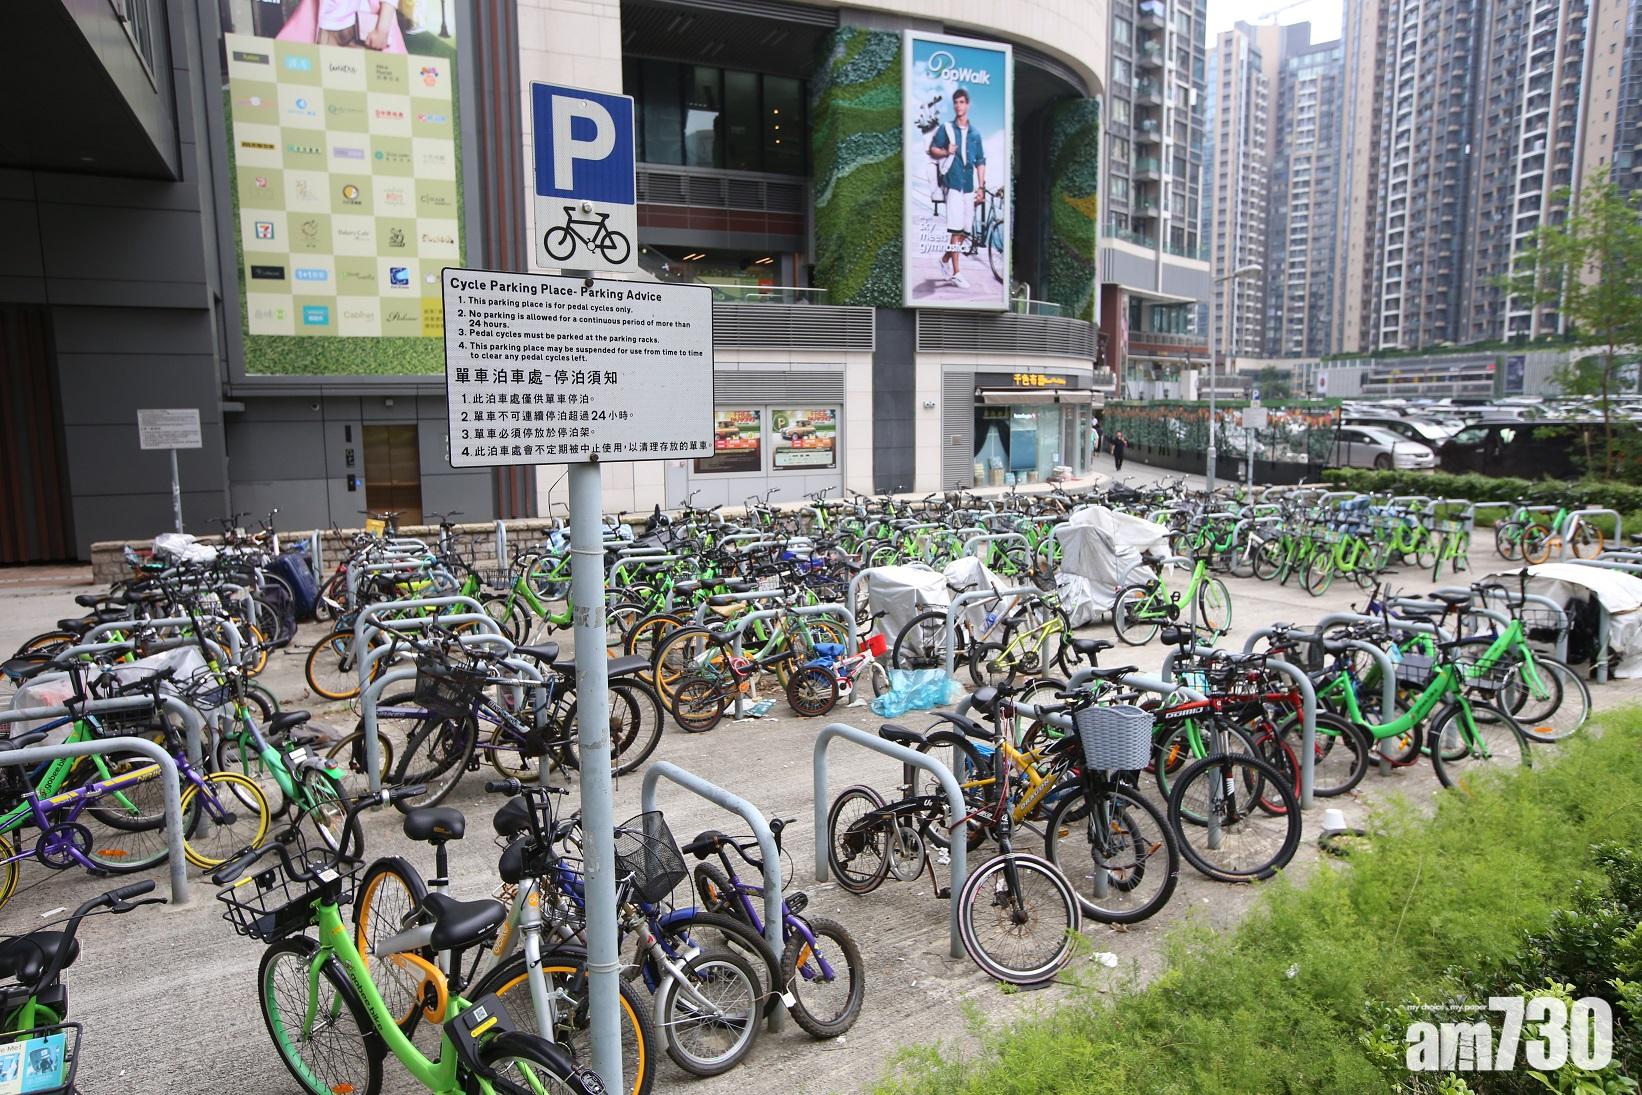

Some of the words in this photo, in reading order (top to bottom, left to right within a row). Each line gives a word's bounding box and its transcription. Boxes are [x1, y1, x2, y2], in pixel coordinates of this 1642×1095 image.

[927, 51, 990, 84] PopWalk
[552, 94, 616, 190] P
[450, 278, 486, 291] Cycle
[490, 280, 537, 295] Parking
[580, 287, 623, 300] Parking
[626, 290, 662, 301] Advice
[488, 299, 520, 307] parking
[522, 300, 543, 308] place
[484, 311, 515, 320] parking
[490, 343, 520, 352] parking
[523, 344, 545, 352] place
